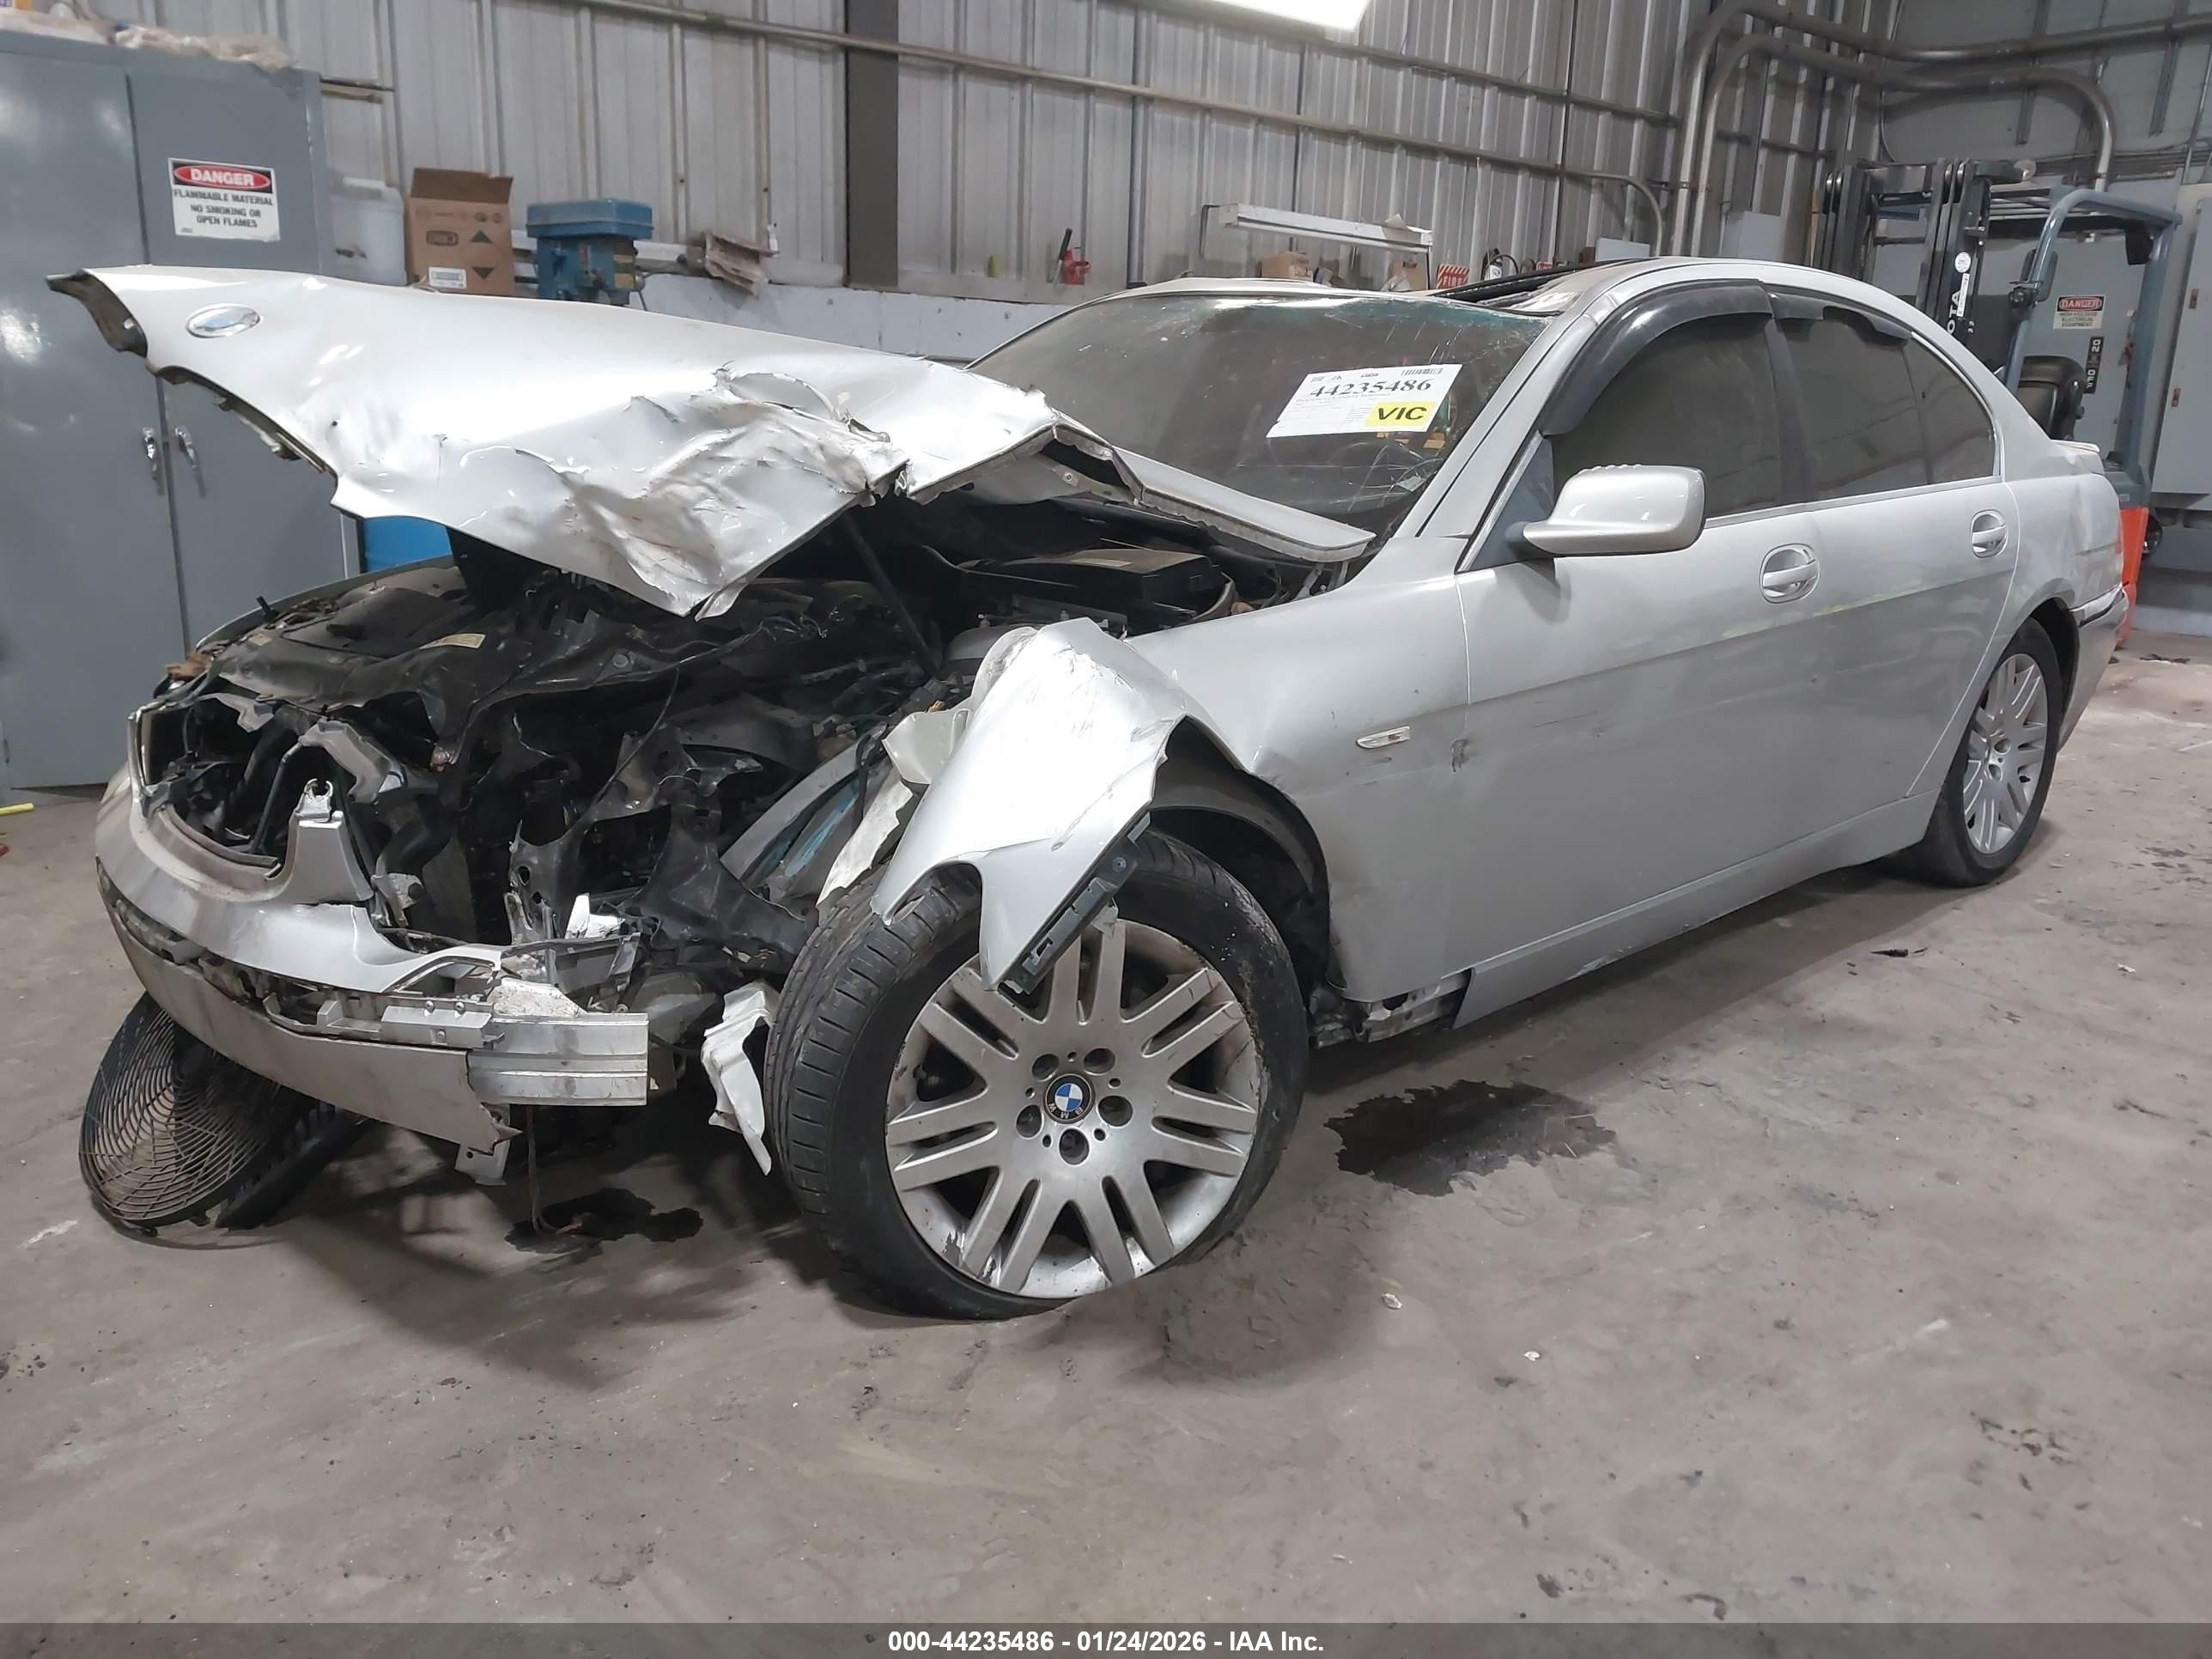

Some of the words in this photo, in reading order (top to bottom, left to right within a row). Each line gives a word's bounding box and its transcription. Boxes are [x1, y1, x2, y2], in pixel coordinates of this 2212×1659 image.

[191, 168, 255, 186] DANGER
[173, 188, 228, 201] FLAMMABLE
[231, 194, 274, 206] MATERIAL
[191, 204, 204, 213] NO
[206, 205, 247, 217] SMOKING
[249, 209, 261, 218] OR
[196, 215, 221, 225] OPEN
[222, 217, 258, 228] FLAMES
[1443, 276, 1463, 286] FIRE
[2061, 299, 2100, 308] DANGER
[1310, 378, 1432, 398] 44235486
[1377, 406, 1428, 421] VIC
